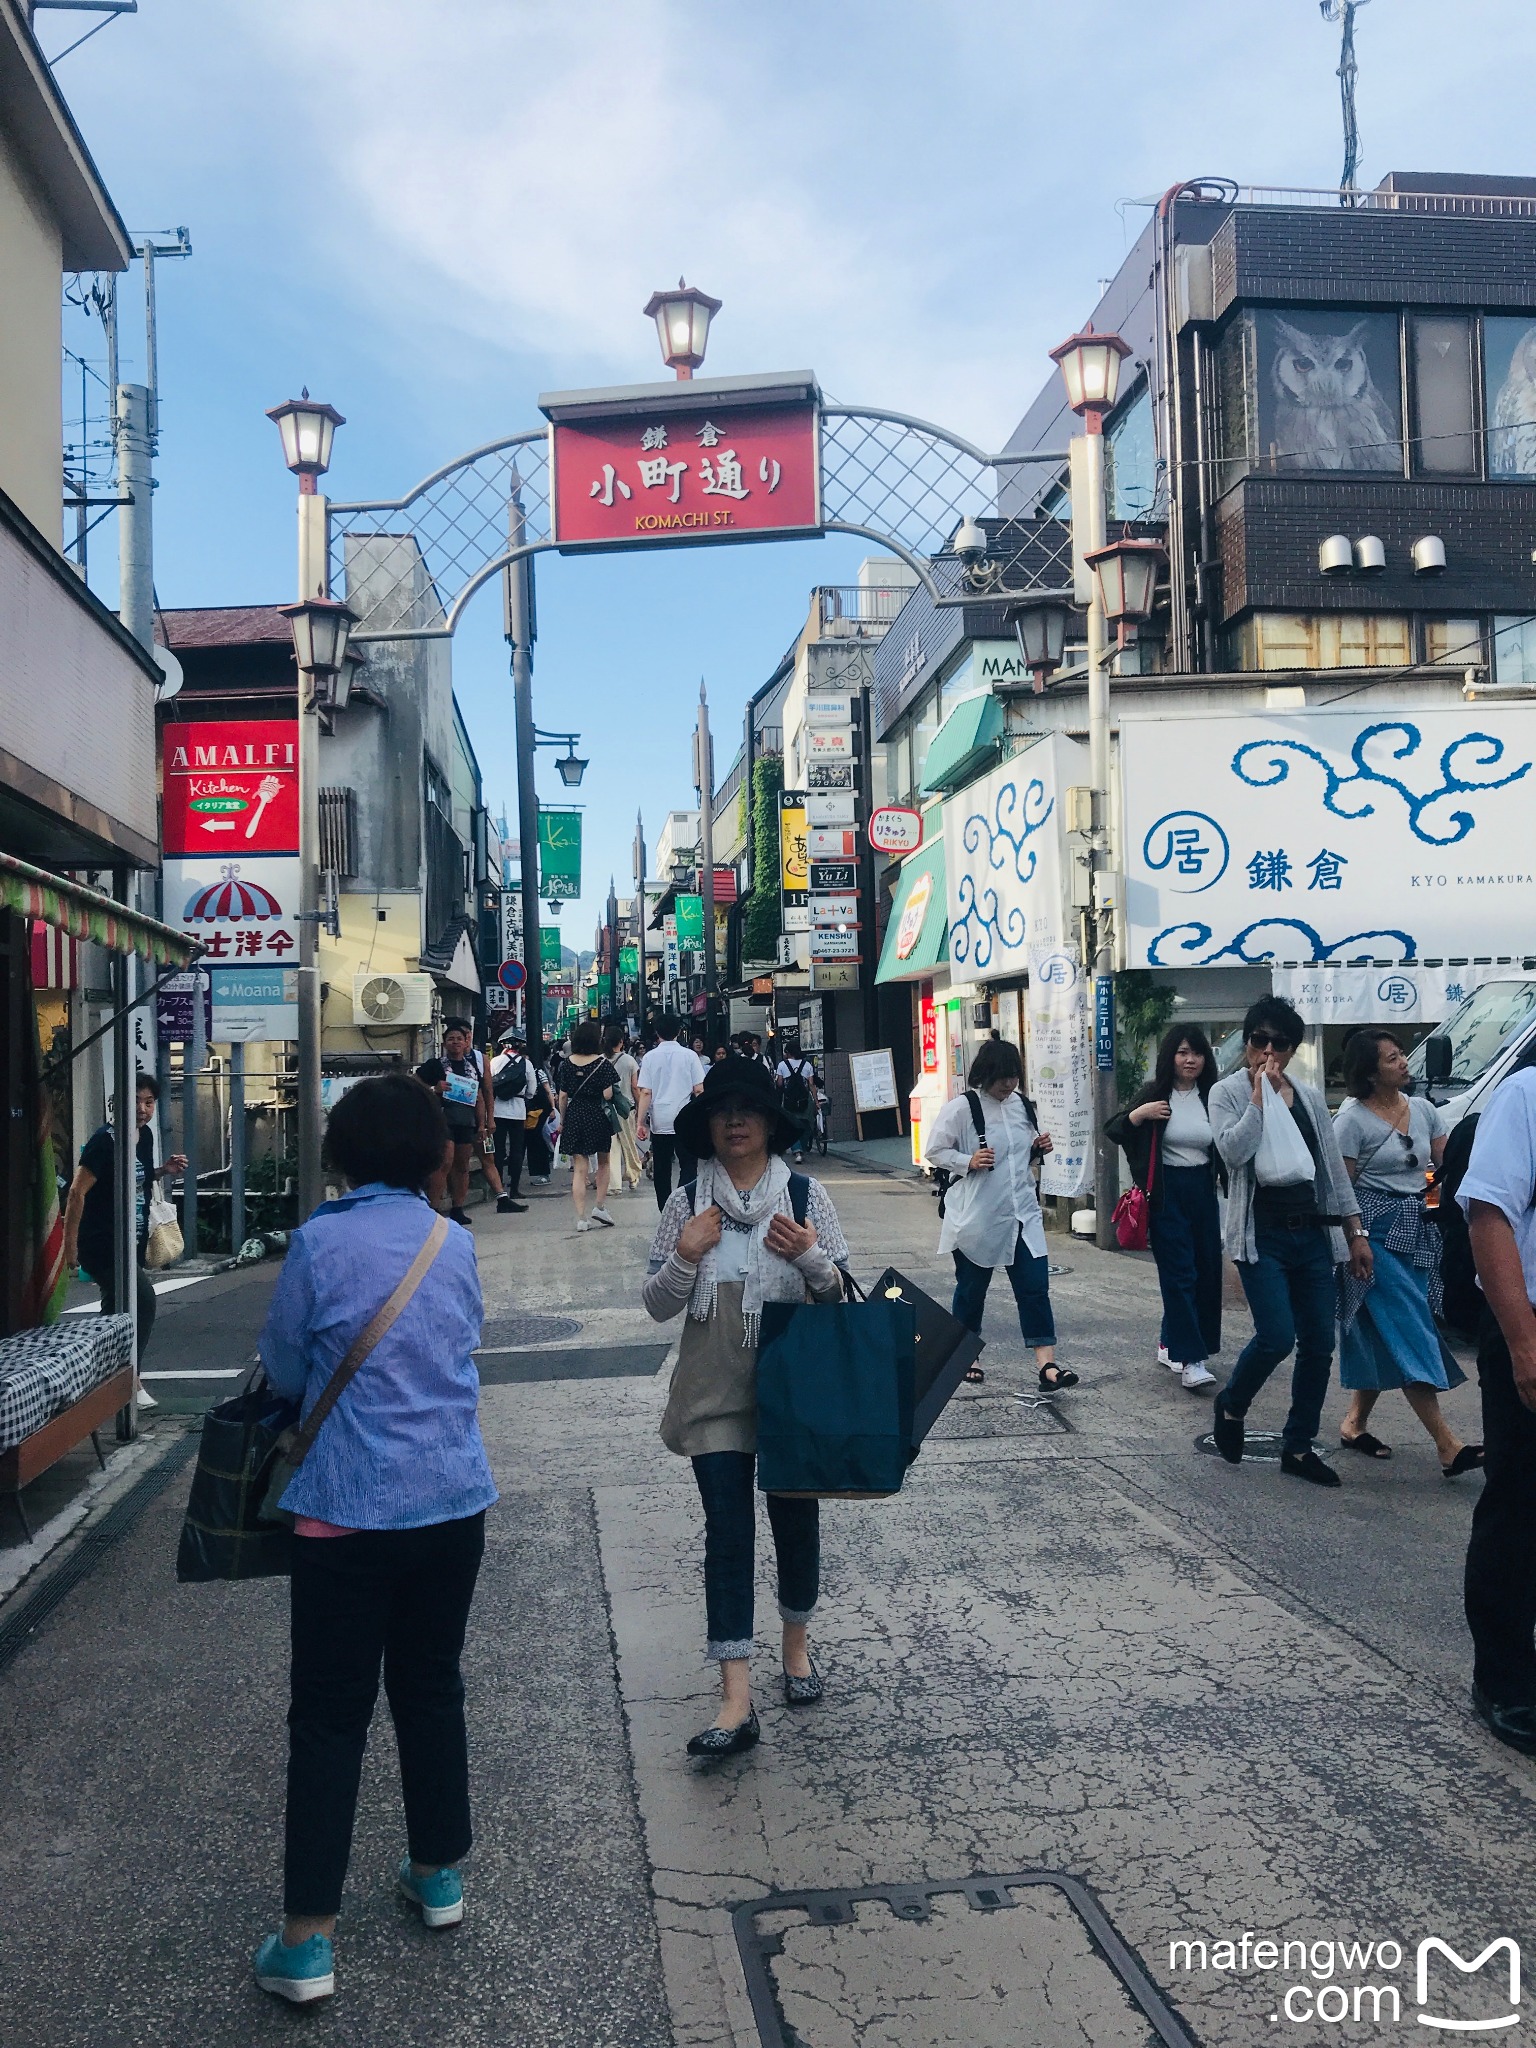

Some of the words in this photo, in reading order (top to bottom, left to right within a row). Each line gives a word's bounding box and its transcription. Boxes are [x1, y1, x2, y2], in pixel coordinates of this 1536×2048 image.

[640, 421, 726, 451] 鎌倉
[589, 449, 781, 506] 小町通り
[635, 512, 709, 530] KOMACHI
[714, 510, 734, 525] ST.
[171, 743, 294, 767] AMALFI
[188, 777, 250, 797] Kitchen
[878, 814, 903, 823] かまくら
[876, 825, 907, 837] りきゅう
[883, 837, 910, 847] RIKYU
[818, 870, 833, 880] Yu
[1246, 848, 1349, 892] 鎌倉
[1411, 875, 1447, 887] KYO
[1457, 874, 1533, 885] KAMAKURA
[791, 893, 809, 905] 1F
[818, 932, 852, 940] KENSHU
[231, 984, 280, 998] Moana
[1302, 984, 1332, 993] KYO
[1099, 986, 1109, 1036] 小町二丁目
[1098, 1039, 1112, 1050] 10
[1068, 1110, 1089, 1118] Green
